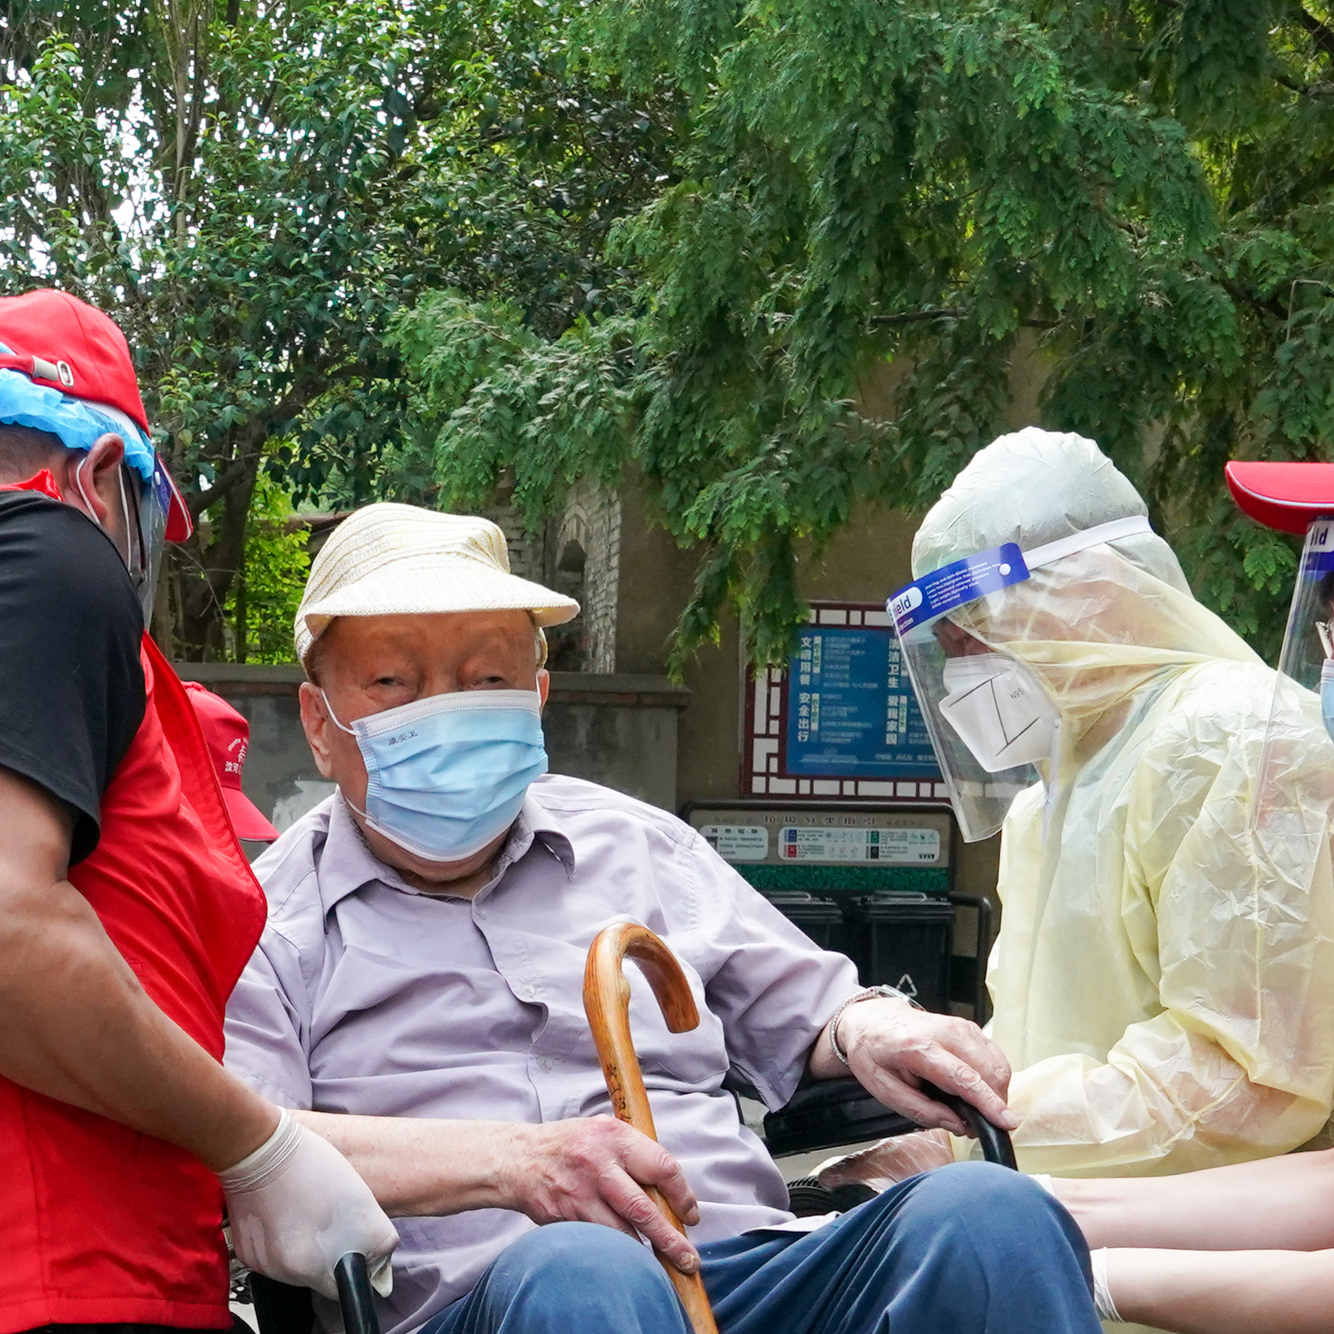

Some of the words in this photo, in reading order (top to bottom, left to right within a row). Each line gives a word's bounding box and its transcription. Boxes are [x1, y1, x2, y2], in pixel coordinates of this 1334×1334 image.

[799, 636, 813, 686] 文明用餐
[797, 692, 811, 743] 安全出行
[1010, 688, 1025, 701] N95
